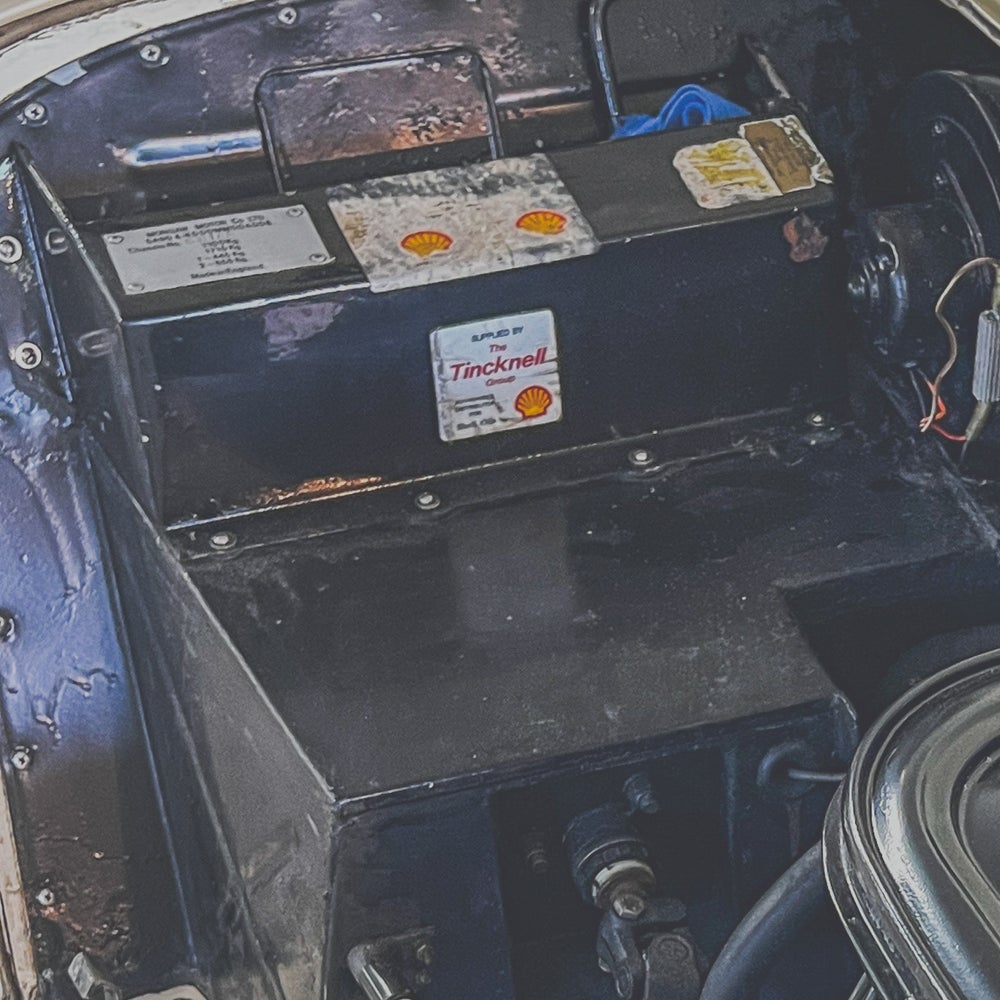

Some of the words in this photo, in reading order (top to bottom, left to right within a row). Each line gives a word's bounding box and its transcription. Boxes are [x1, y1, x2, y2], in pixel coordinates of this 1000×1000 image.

[471, 328, 510, 342] SUPPLIED
[512, 326, 524, 335] BY
[489, 344, 507, 353] The
[450, 346, 548, 381] Tincknell
[485, 375, 516, 387] Group
